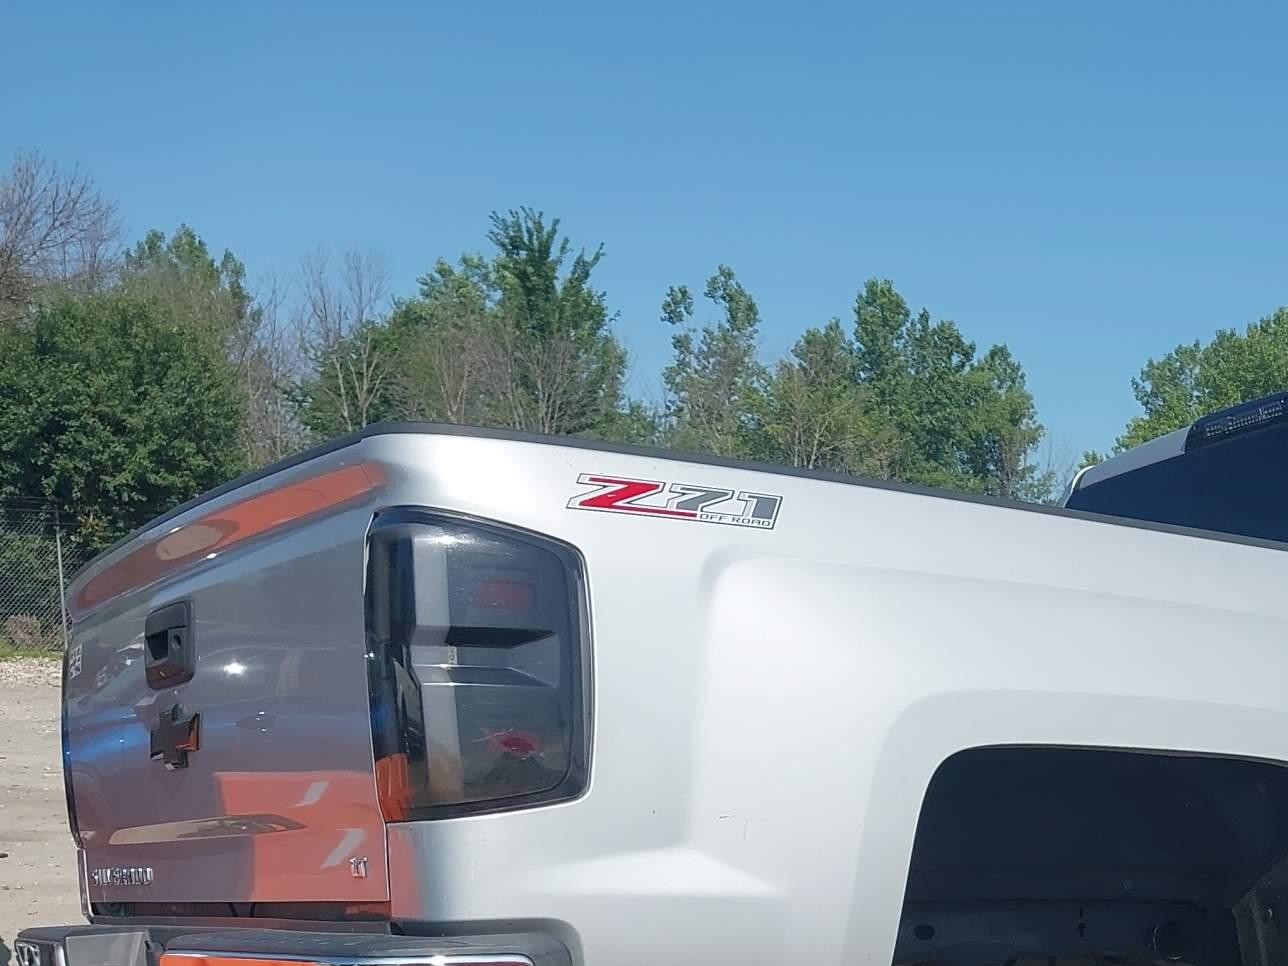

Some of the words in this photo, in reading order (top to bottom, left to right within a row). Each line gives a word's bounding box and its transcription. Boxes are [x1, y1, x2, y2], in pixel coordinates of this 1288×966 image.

[566, 473, 783, 530] Z71
[699, 513, 728, 522] OFF
[731, 516, 771, 527] ROAD
